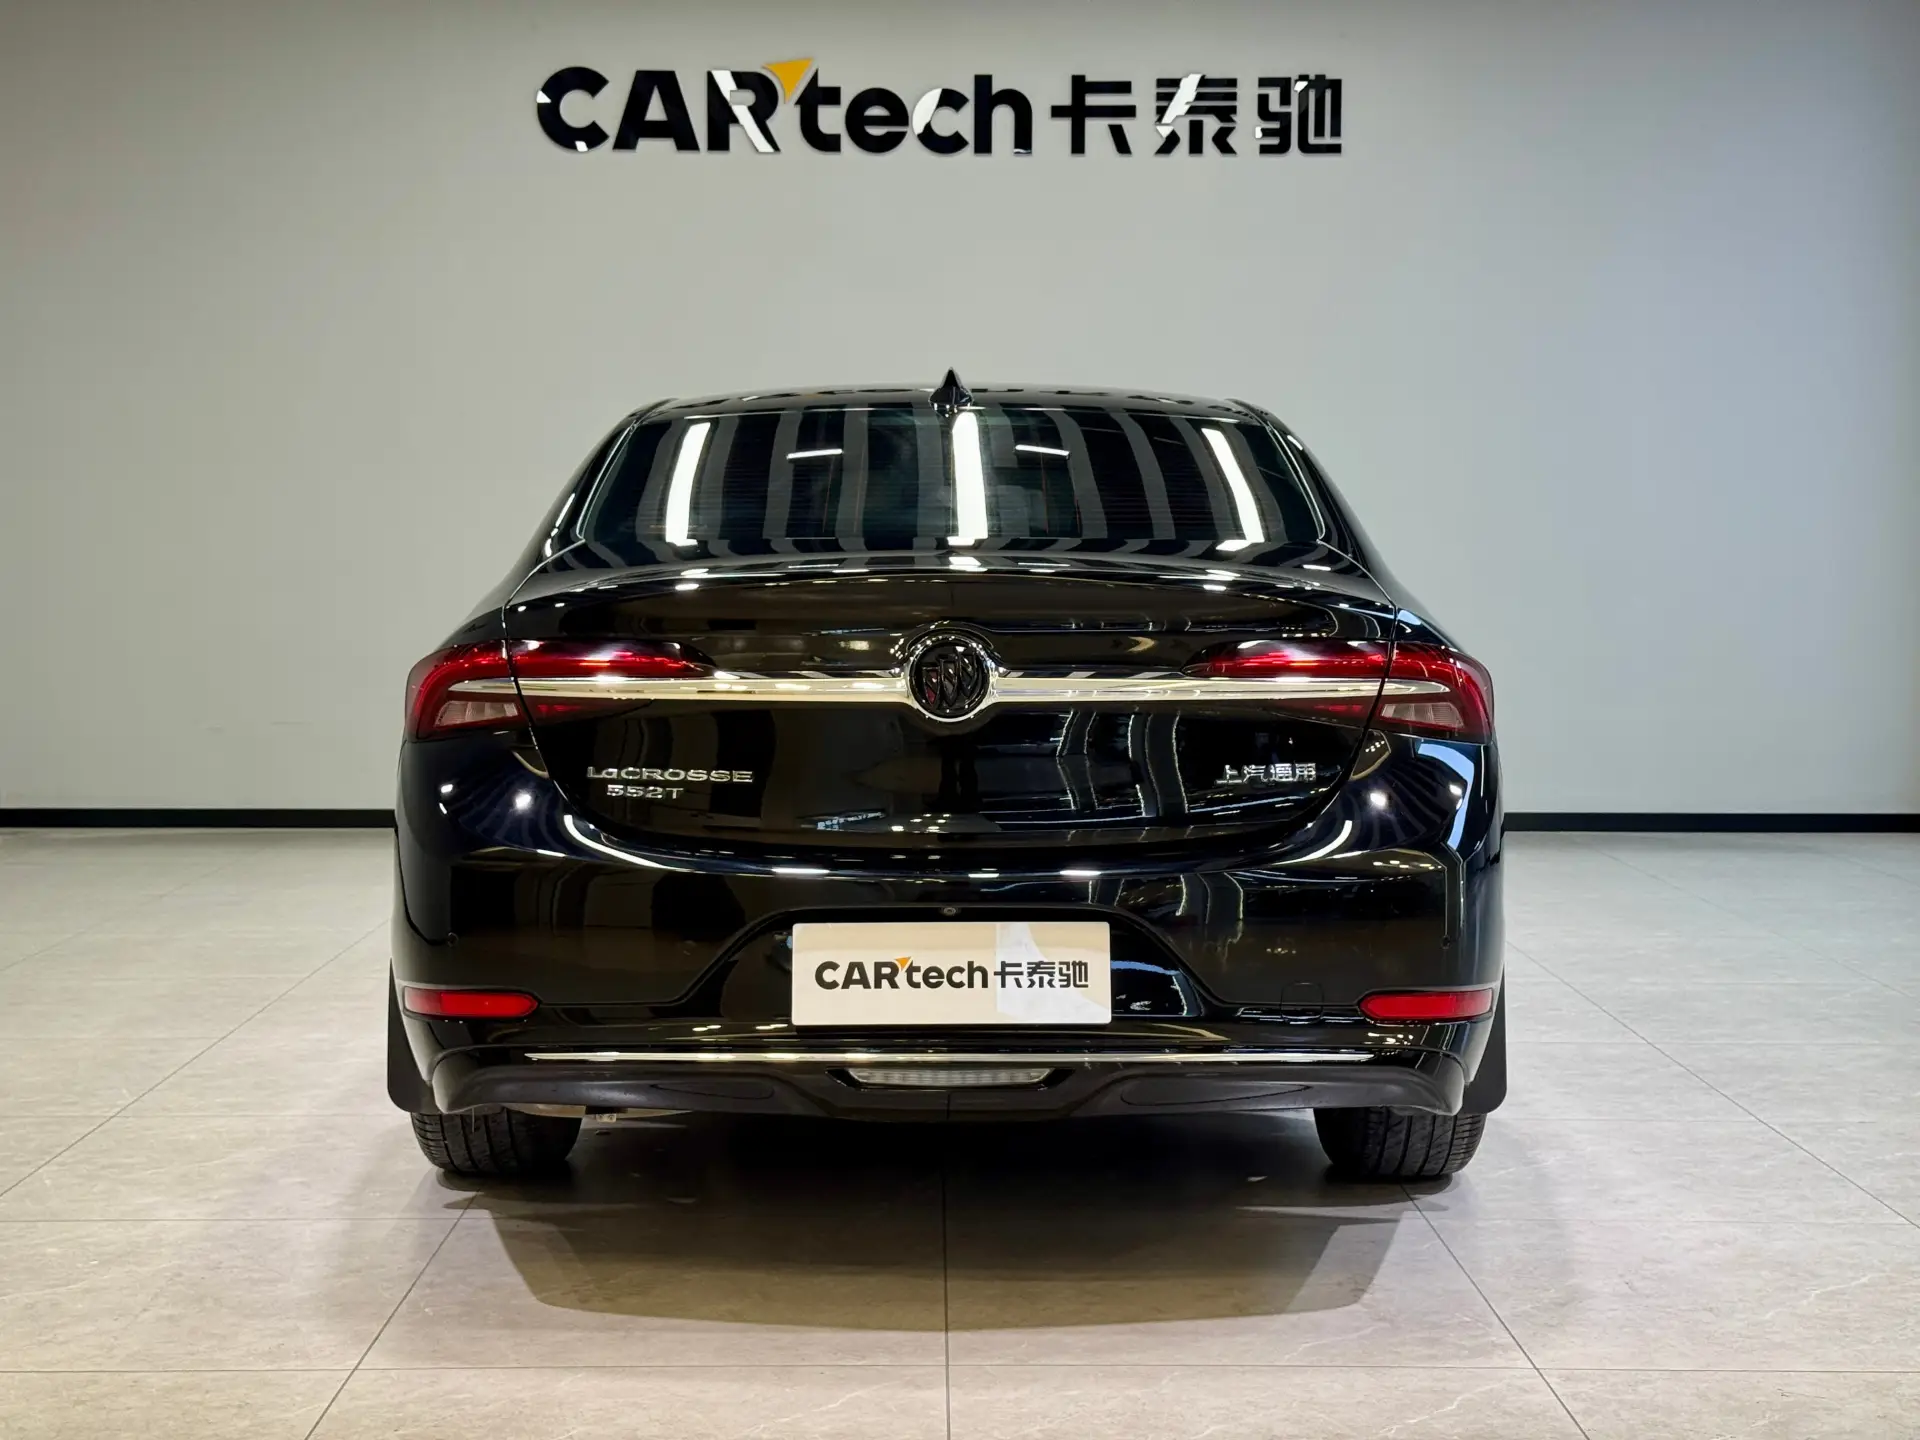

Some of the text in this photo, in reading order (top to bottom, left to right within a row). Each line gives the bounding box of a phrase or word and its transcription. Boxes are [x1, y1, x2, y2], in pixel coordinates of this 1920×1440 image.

[536, 62, 1344, 155] CARtech 卡泰驰
[1214, 762, 1317, 785] 上汽通用
[606, 784, 684, 799] 552T
[814, 959, 1090, 991] CARtech 卡泰驰
